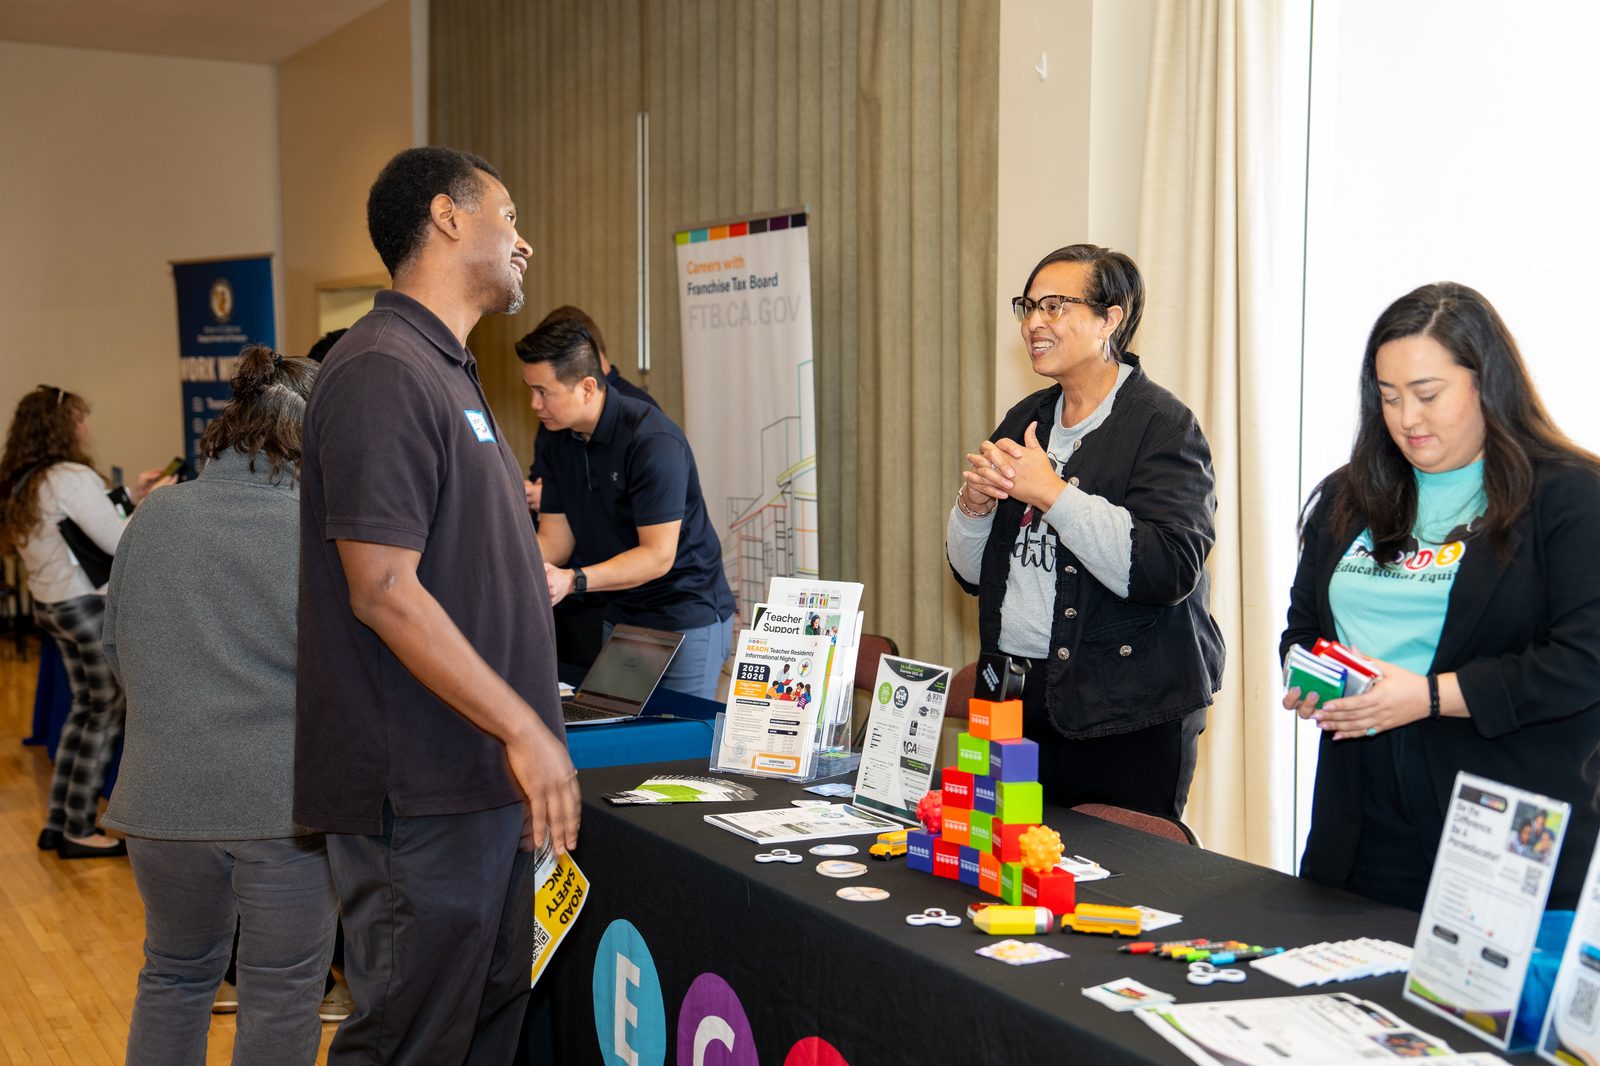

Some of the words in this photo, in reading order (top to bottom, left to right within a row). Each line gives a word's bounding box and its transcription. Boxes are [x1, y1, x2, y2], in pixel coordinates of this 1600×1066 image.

[686, 261, 721, 275] Careers
[723, 255, 745, 270] with
[687, 278, 730, 296] Franchise
[731, 276, 747, 290] Tax
[749, 272, 779, 289] Board
[688, 294, 802, 331] FTB.CA.GOV
[1419, 569, 1458, 584] Equi
[765, 611, 803, 624] Teacher
[763, 622, 800, 635] Support
[745, 652, 779, 661] Informational
[779, 655, 797, 663] Nights
[746, 644, 769, 653] REACH
[770, 647, 790, 656] Teacher
[790, 649, 815, 658] Residency
[741, 671, 764, 680] 2026
[742, 664, 766, 673] 2025
[542, 863, 564, 891] INC.
[546, 867, 576, 919] SAFETY
[560, 884, 583, 925] ROAD
